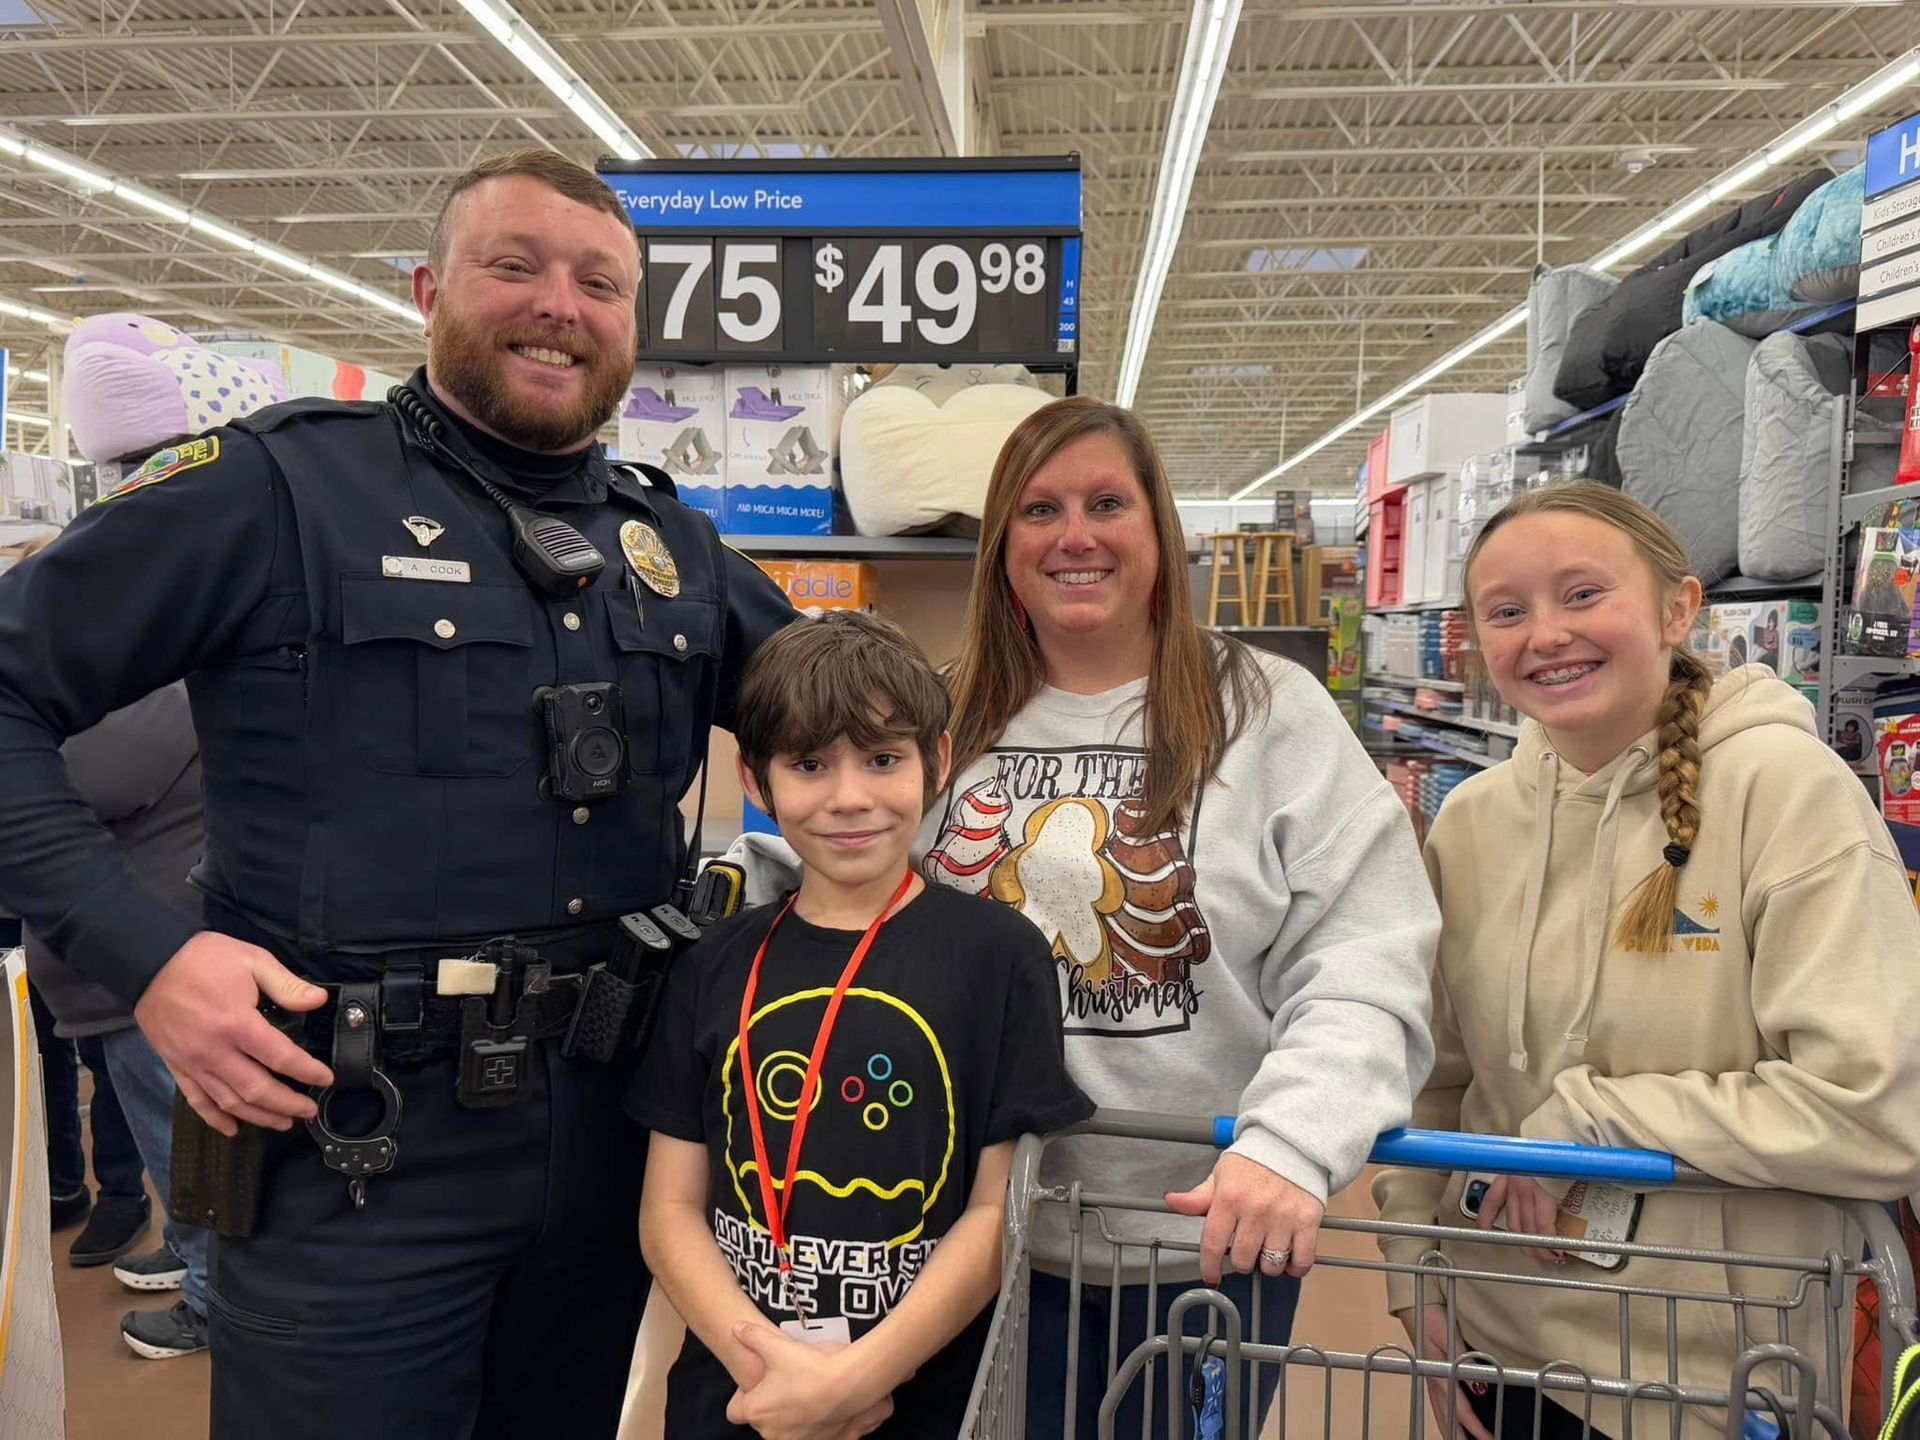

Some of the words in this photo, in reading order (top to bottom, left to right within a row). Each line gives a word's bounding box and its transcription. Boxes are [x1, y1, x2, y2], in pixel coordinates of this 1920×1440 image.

[616, 189, 704, 215] Everyday
[710, 189, 748, 209] Low
[754, 189, 803, 209] Price
[1873, 205, 1890, 220] Kids
[1876, 230, 1917, 252] Children's
[1879, 261, 1920, 284] Children's
[639, 244, 781, 343] 75
[1059, 323, 1075, 332] 200
[429, 565, 462, 575] COOK
[592, 779, 612, 788] AXON
[986, 754, 1063, 800] FOR
[1069, 753, 1150, 799] THE
[1681, 937, 1720, 952] VIDA
[789, 1235, 890, 1278] EVER
[840, 1275, 913, 1320] OV
